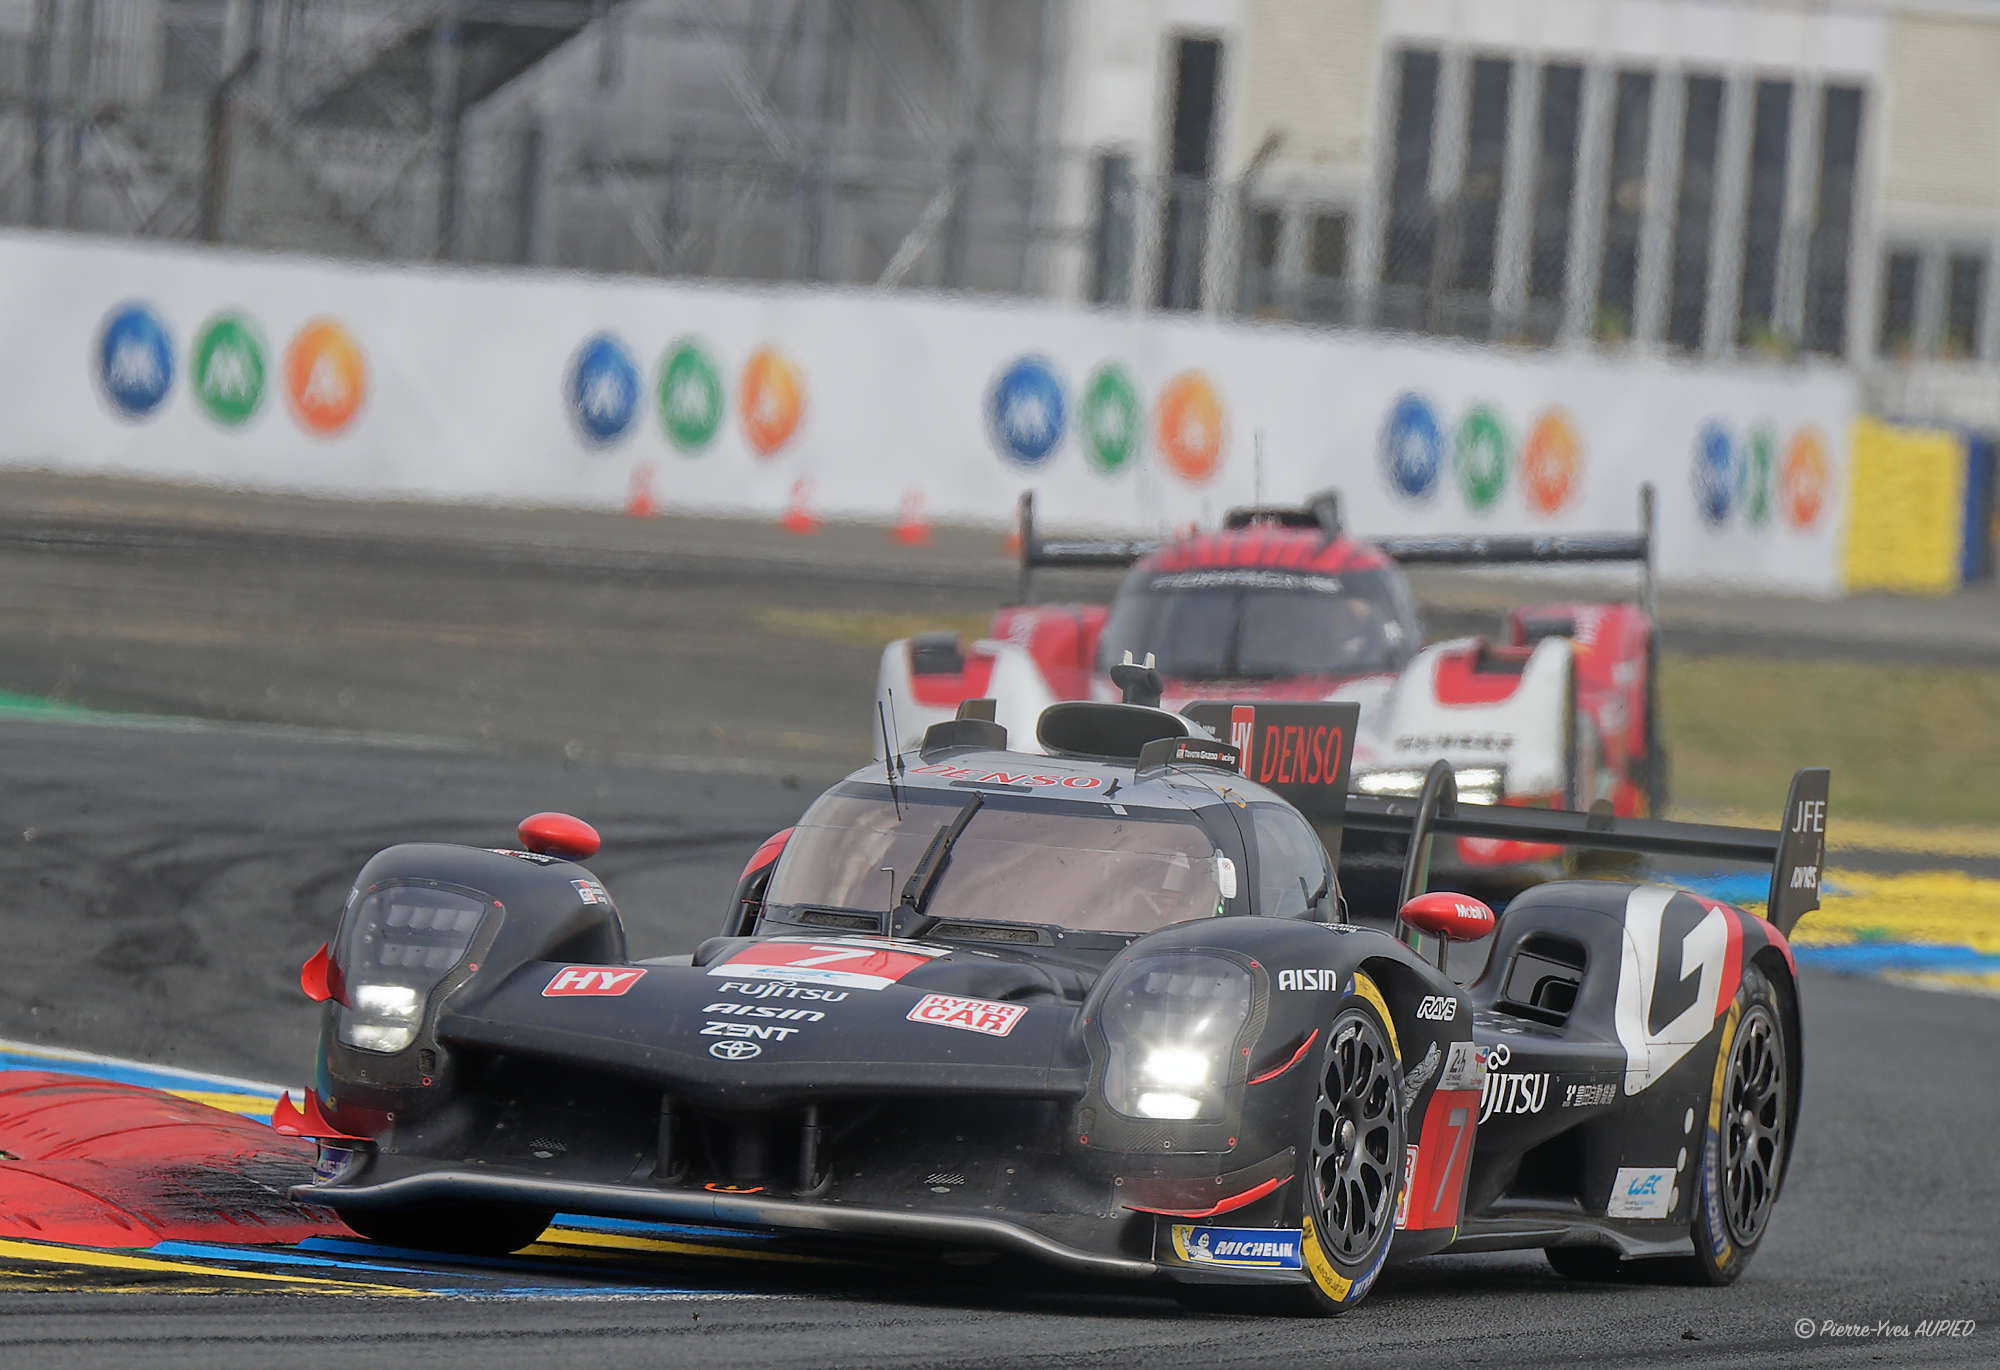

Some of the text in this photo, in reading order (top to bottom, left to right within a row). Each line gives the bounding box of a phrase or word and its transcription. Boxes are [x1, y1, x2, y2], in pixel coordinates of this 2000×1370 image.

[1260, 725, 1342, 785] DENSO
[910, 764, 1101, 789] DENSO
[1792, 800, 1826, 832] JFE
[784, 945, 874, 967] 7
[552, 970, 636, 990] HY
[1278, 969, 1337, 991] AISIN
[718, 981, 849, 1002] FUJITSU
[702, 1002, 825, 1022] AISIN
[929, 997, 1015, 1016] HYPER
[1416, 995, 1457, 1021] RAYS
[920, 1005, 1008, 1031] CAR
[700, 1021, 799, 1042] ZENT
[1432, 1107, 1469, 1213] 7
[1627, 1174, 1662, 1195] WEC
[1214, 1240, 1293, 1257] MICHELIN
